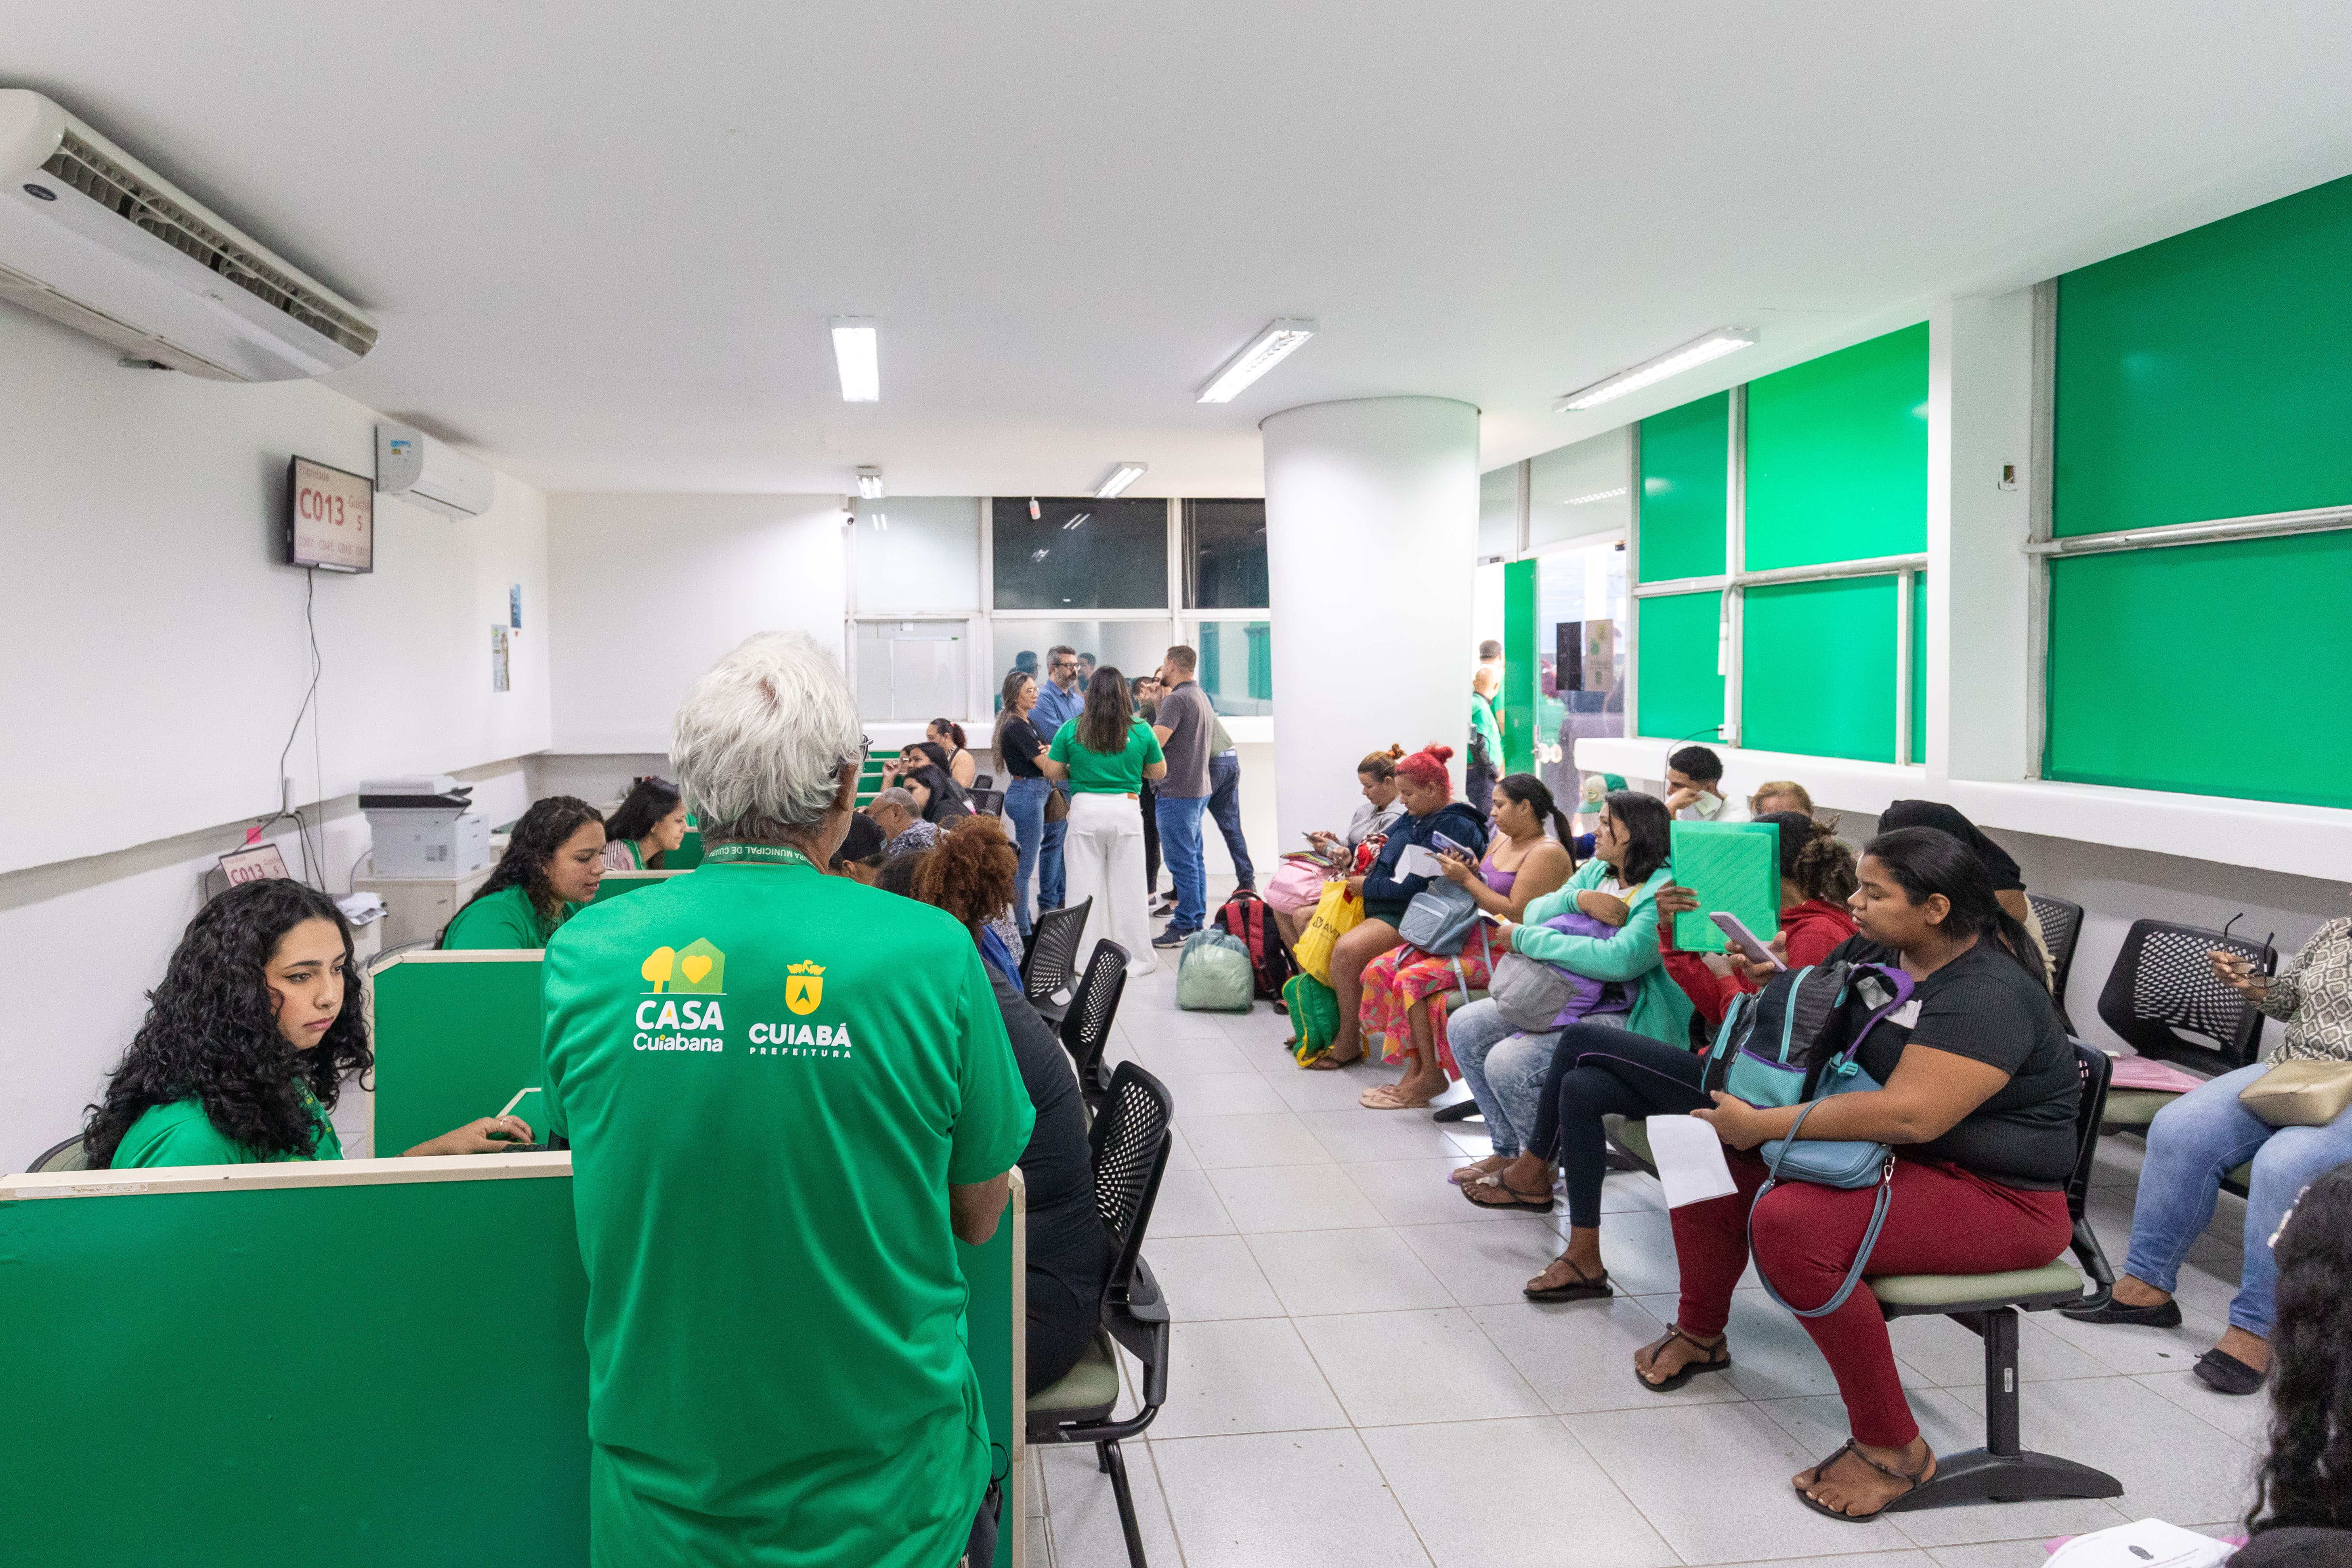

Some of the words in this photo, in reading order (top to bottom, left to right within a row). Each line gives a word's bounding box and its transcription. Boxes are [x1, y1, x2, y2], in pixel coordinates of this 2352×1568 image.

[300, 488, 344, 526] C013
[357, 515, 362, 531] 5
[745, 846, 793, 857] MUNICIPAL
[231, 863, 265, 884] C013
[636, 1000, 724, 1031] CASA
[633, 1032, 724, 1052] Cuiabana
[749, 1022, 852, 1047] CUIABÁ
[750, 1047, 851, 1058] PREFEITURA
